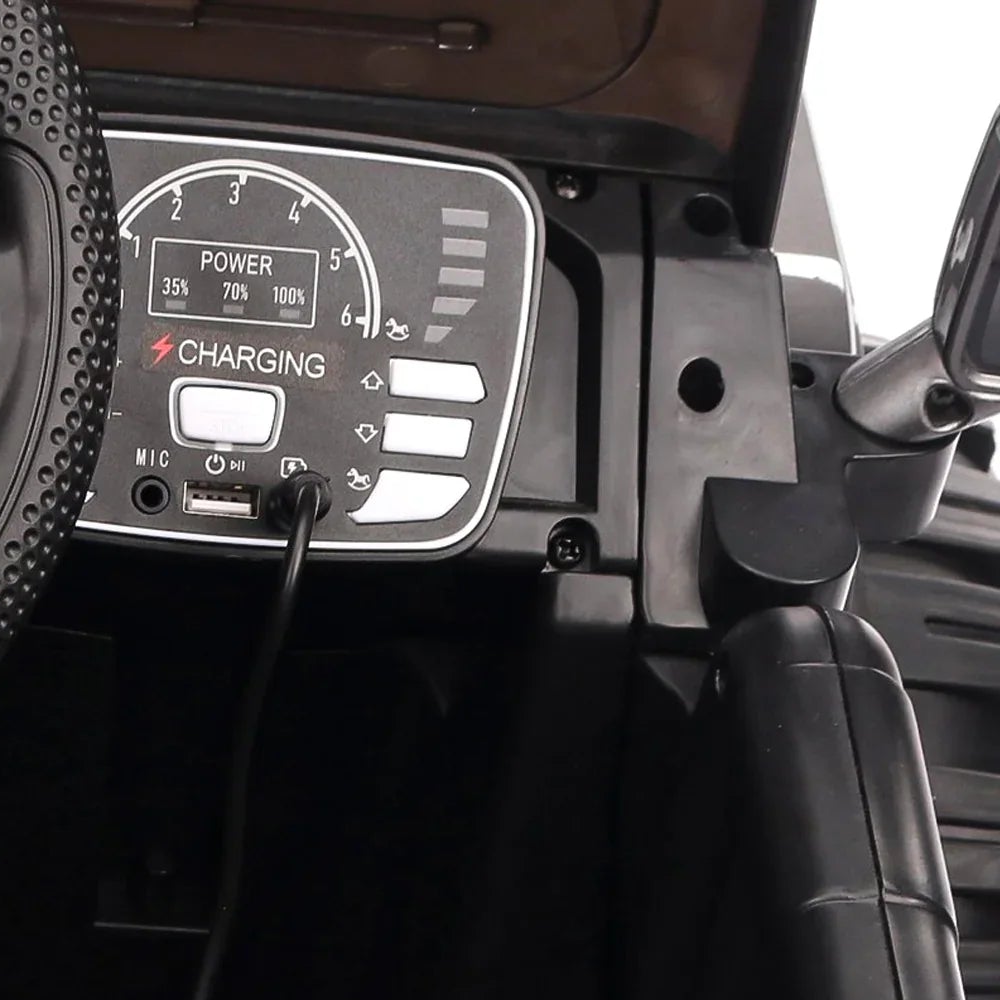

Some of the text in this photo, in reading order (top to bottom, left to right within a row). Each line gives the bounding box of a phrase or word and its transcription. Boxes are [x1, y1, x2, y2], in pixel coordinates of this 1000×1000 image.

[228, 182, 241, 205] 3
[171, 198, 182, 221] 2
[288, 202, 301, 225] 4
[130, 235, 141, 258] 1
[200, 250, 273, 277] POWER
[329, 247, 341, 272] 5
[161, 277, 306, 306] 35% 70% 100%
[341, 304, 352, 327] 6
[178, 338, 327, 379] CHARGING
[135, 447, 170, 468] MIC
